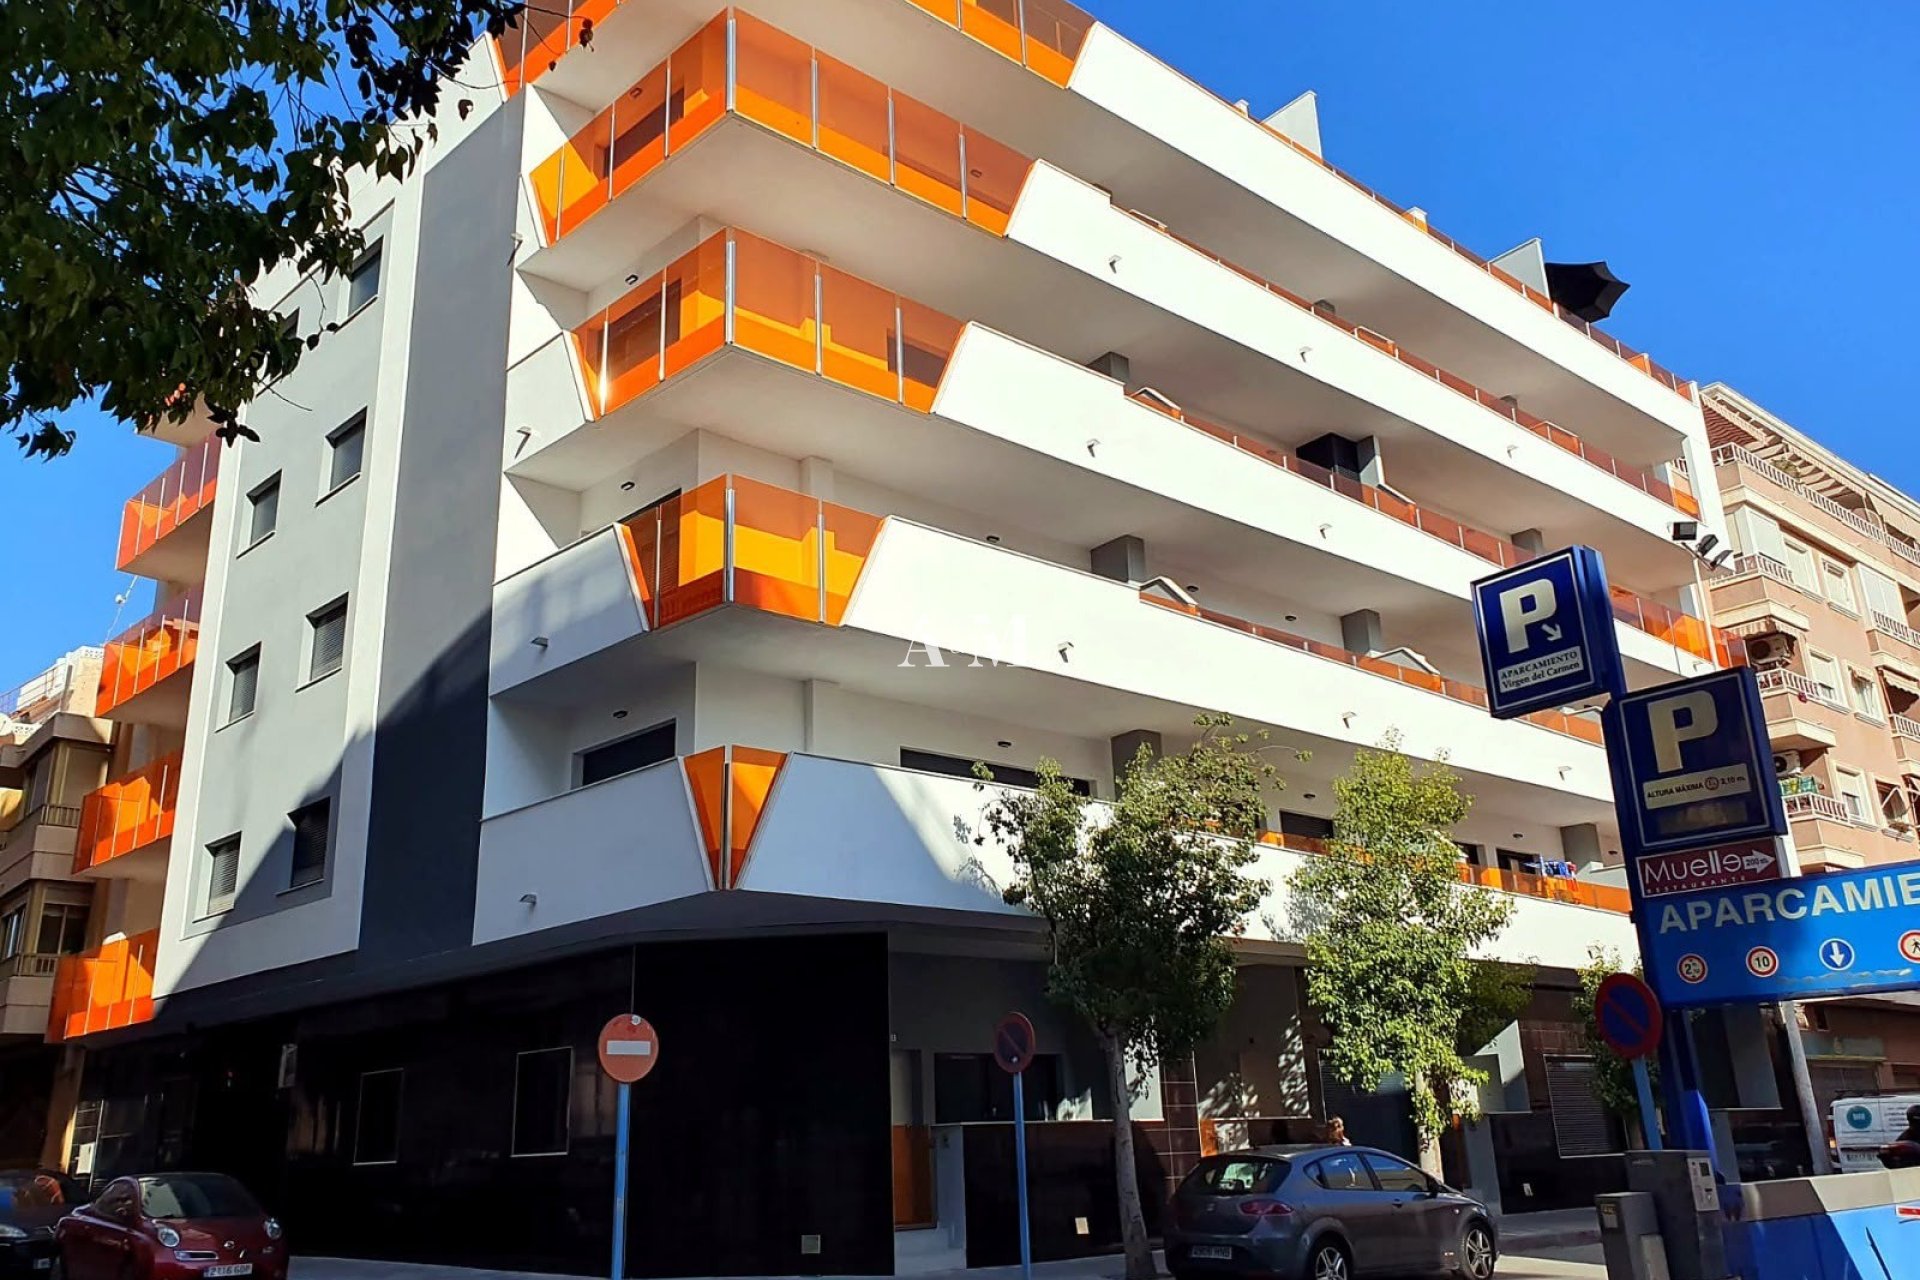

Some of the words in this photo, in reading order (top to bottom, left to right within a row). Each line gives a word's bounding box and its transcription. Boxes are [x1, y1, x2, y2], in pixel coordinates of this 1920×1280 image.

[1499, 579, 1557, 653] P
[1501, 651, 1578, 679] APARCAMIENTO
[1502, 676, 1530, 689] Virgen
[1531, 670, 1545, 681] del
[1546, 662, 1580, 676] Carmen
[1648, 690, 1718, 773] P
[1647, 788, 1674, 798] ALTURA
[1645, 850, 1741, 884] Muelle
[1755, 956, 1770, 968] 10
